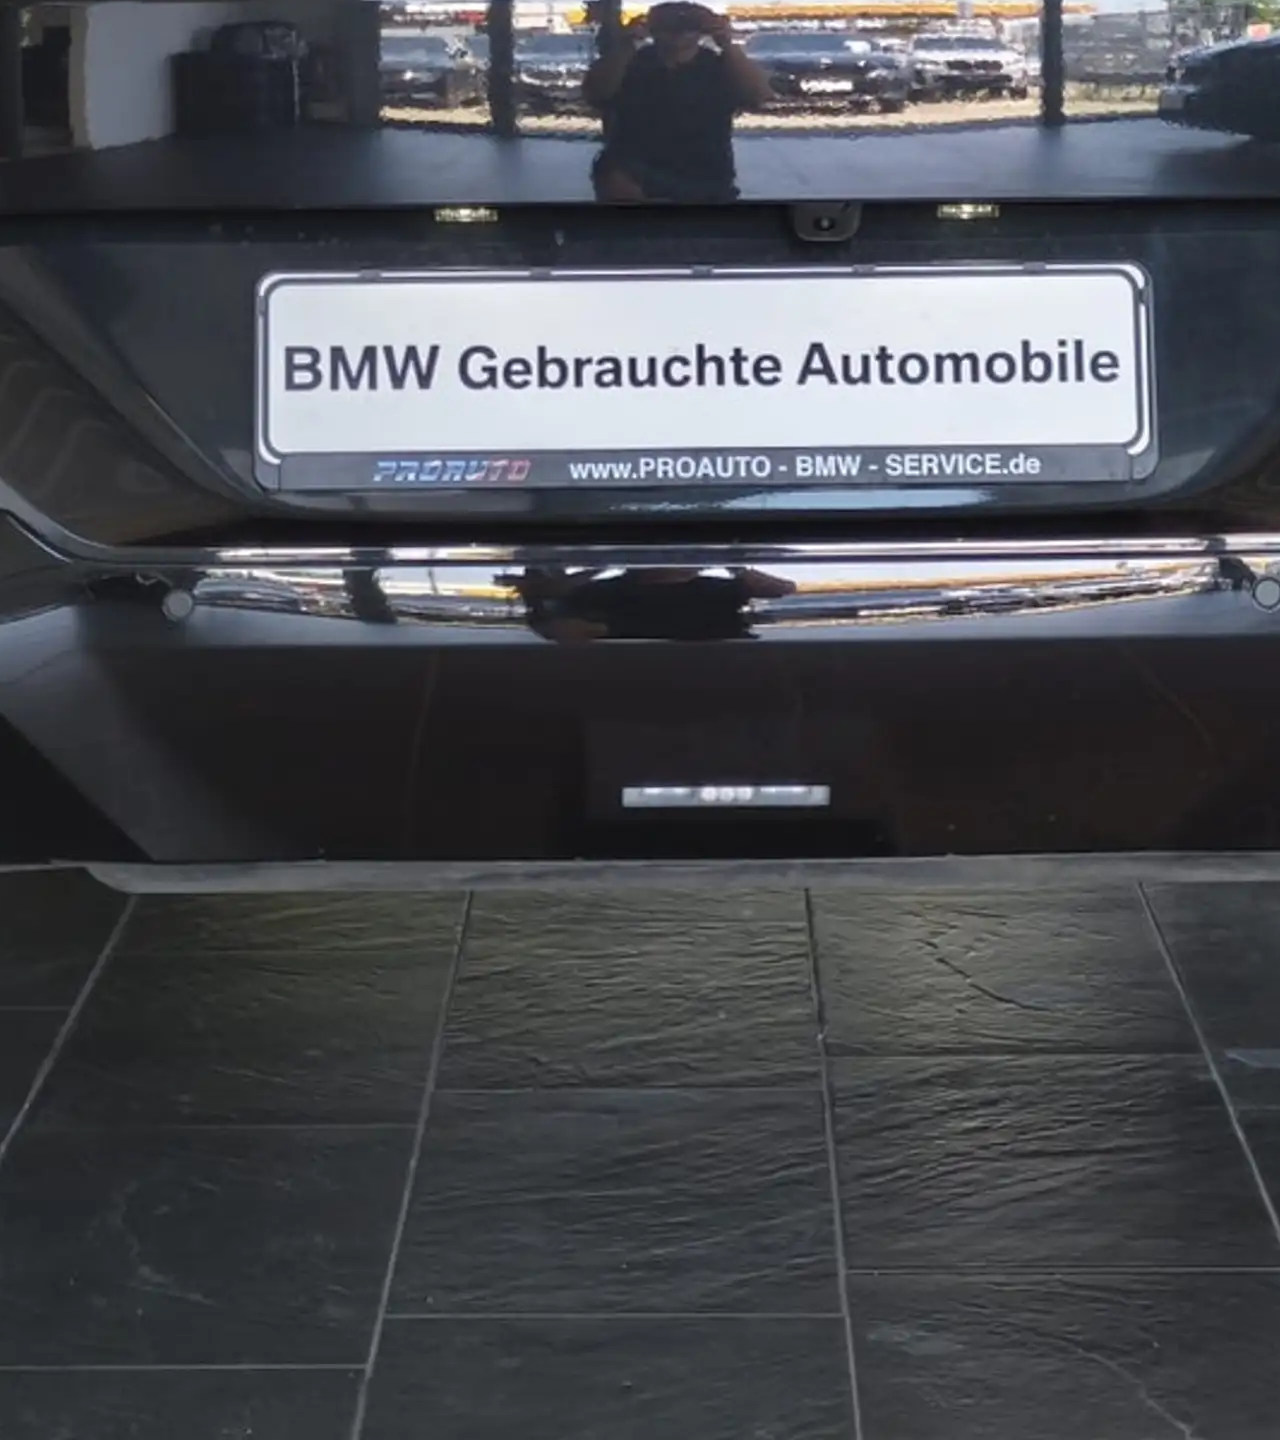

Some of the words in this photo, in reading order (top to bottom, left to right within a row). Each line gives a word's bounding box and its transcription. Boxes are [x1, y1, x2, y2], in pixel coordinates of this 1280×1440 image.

[284, 345, 440, 391] BMW
[458, 343, 782, 389] Gebrauchte
[797, 340, 1120, 386] Automobile
[373, 460, 531, 482] PROAUTO
[796, 455, 862, 477] BMW
[885, 453, 1041, 477] SERVICE.de
